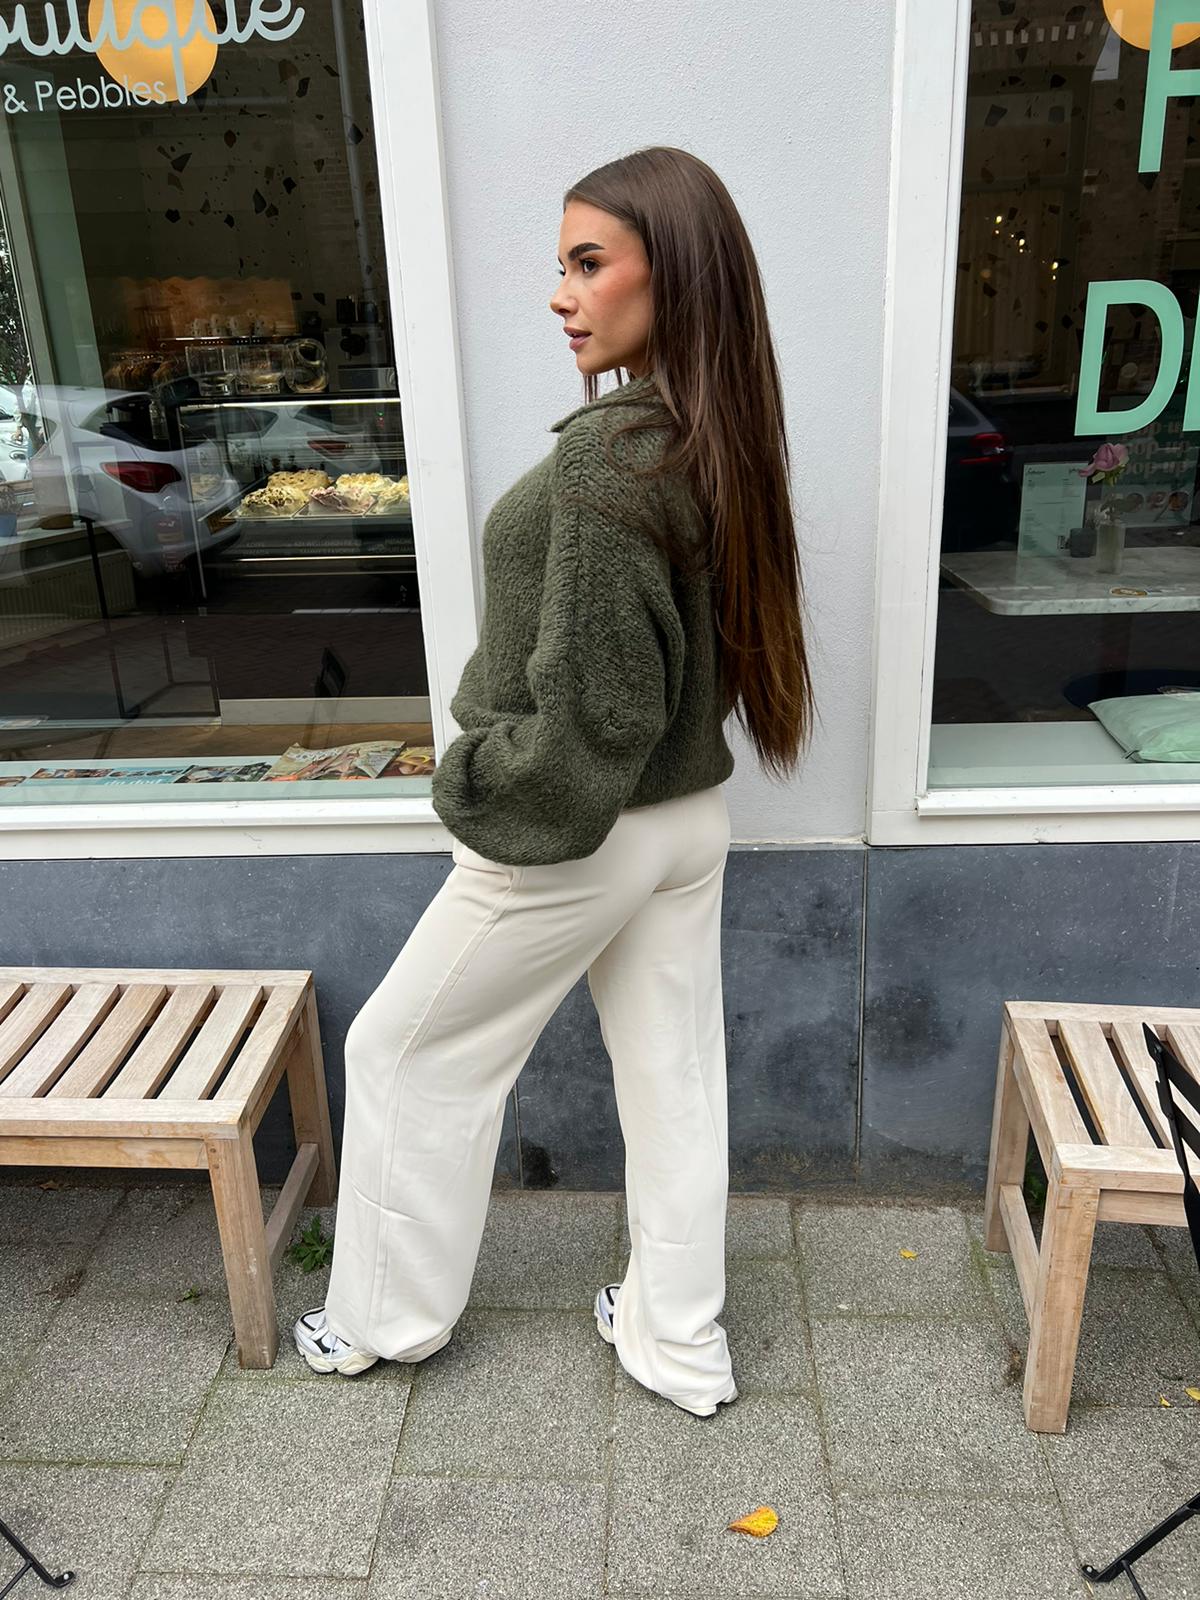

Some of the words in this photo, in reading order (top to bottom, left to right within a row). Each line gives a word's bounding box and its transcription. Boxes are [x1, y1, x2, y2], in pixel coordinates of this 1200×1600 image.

[0, 0, 305, 104] utique
[3, 84, 29, 114] &
[34, 74, 167, 112] Pebbles
